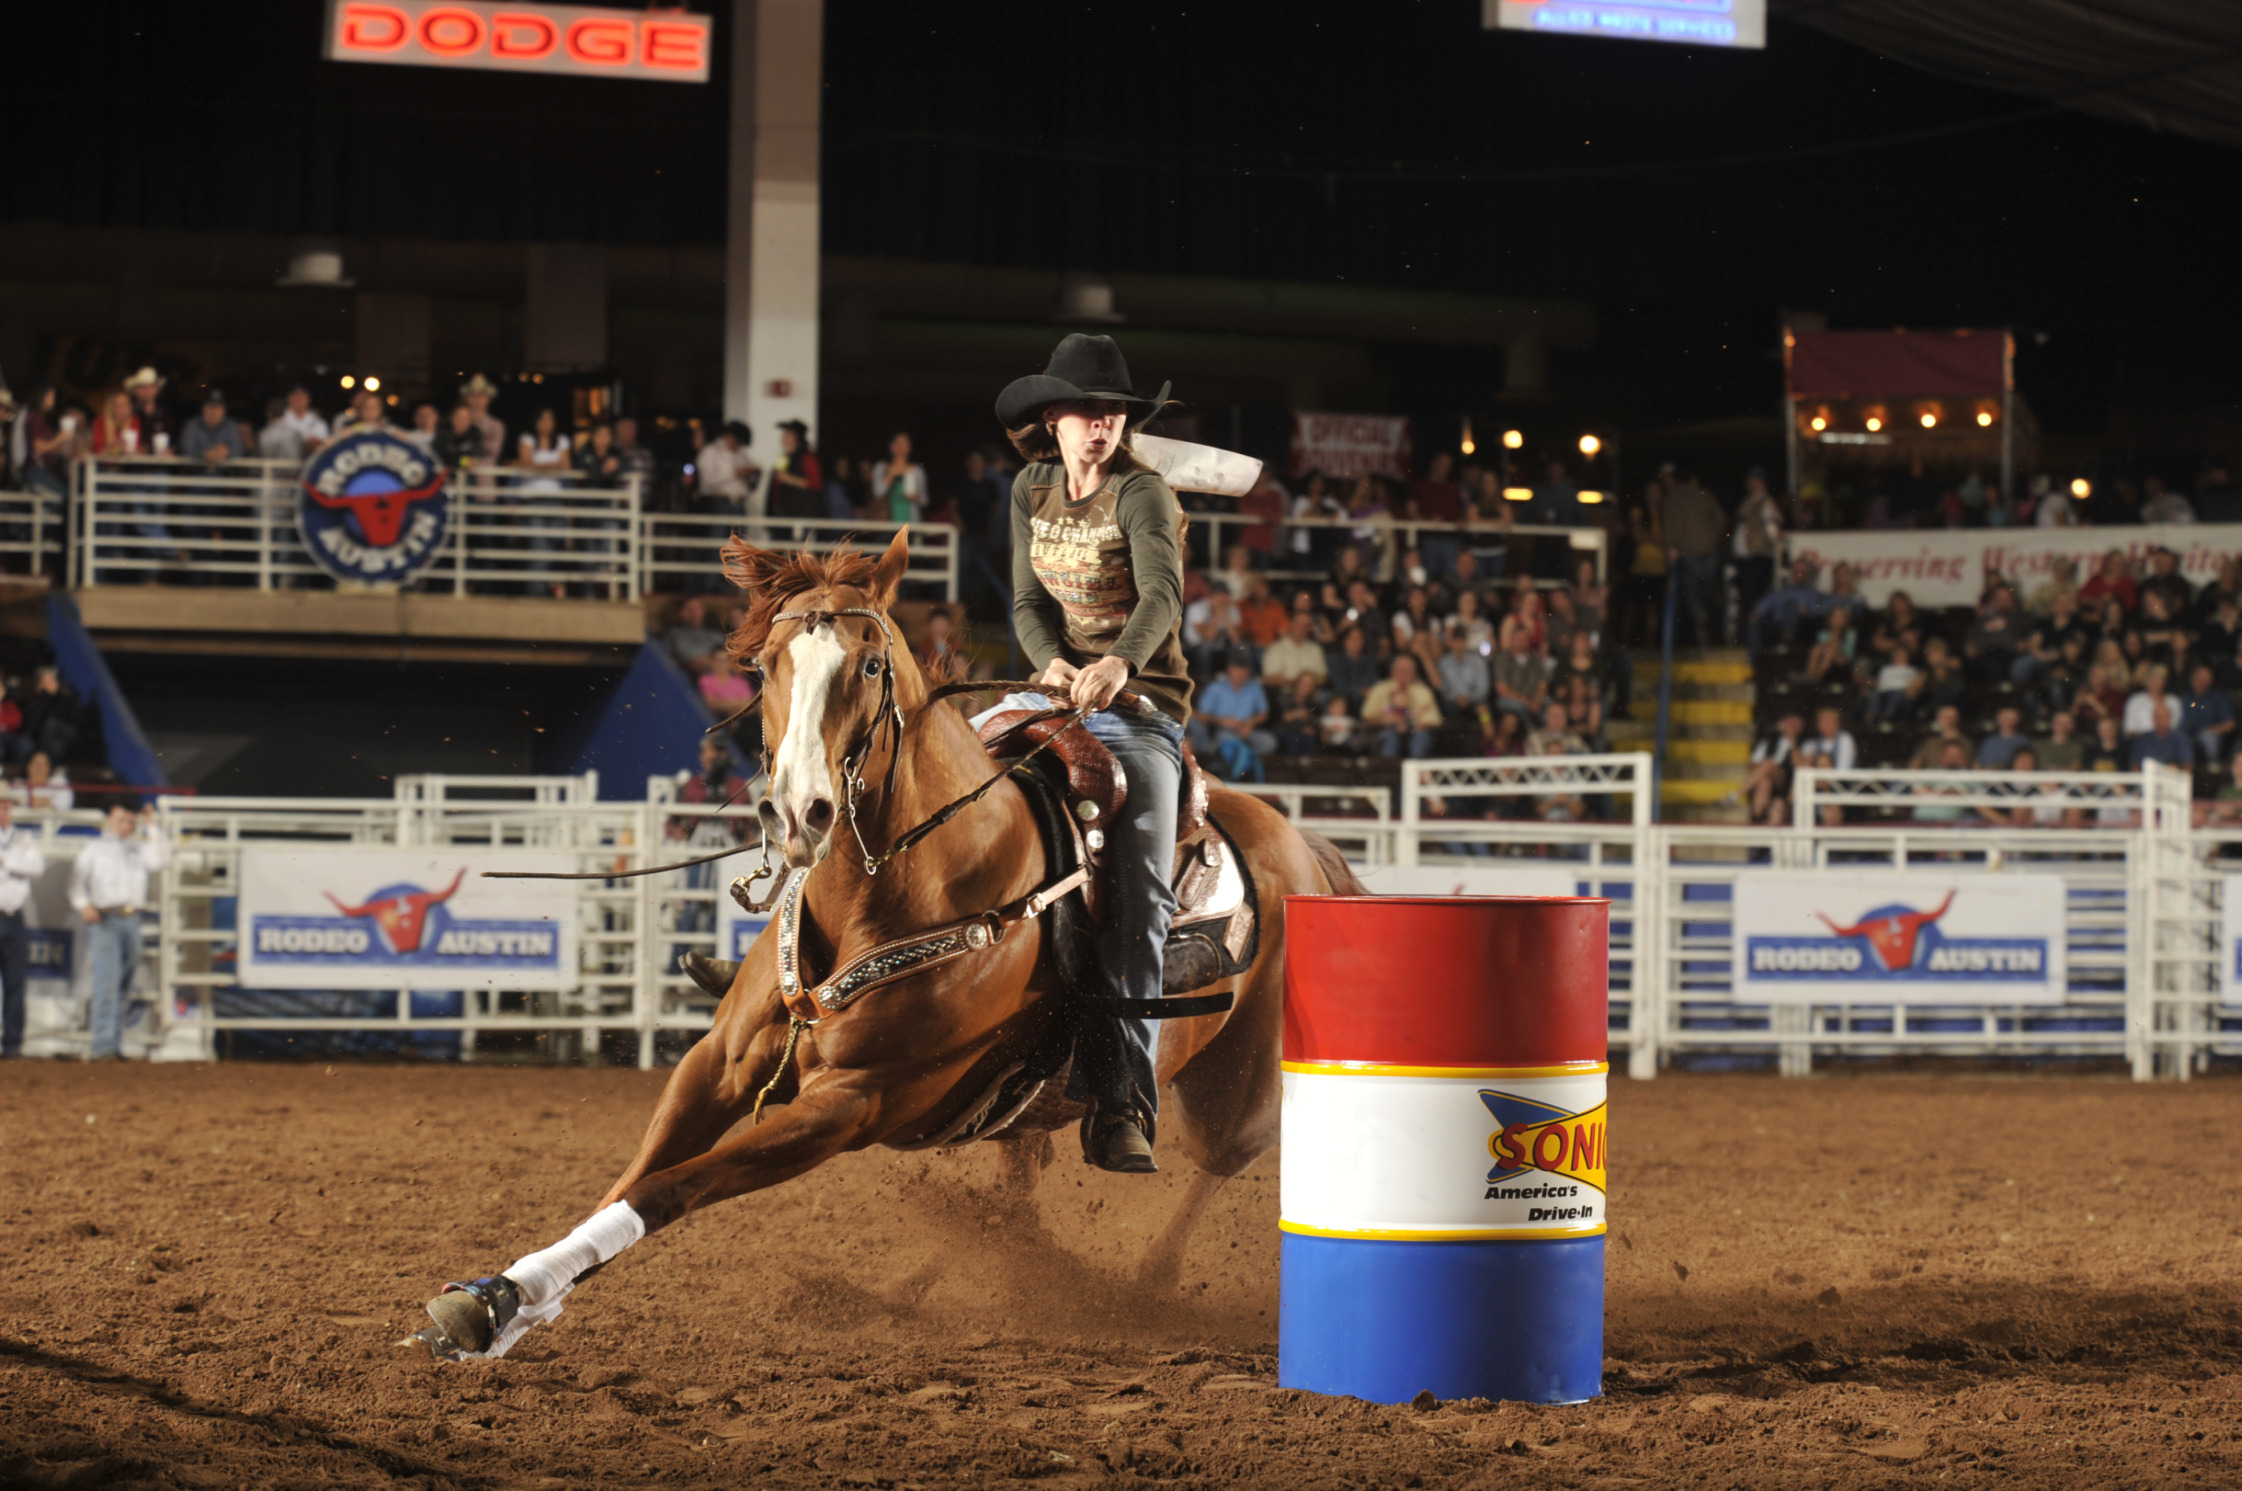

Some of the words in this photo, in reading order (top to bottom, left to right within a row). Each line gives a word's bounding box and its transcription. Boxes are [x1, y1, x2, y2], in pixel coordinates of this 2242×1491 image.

[342, 4, 705, 71] DODGE
[316, 443, 426, 499] RODEO
[318, 511, 437, 573] AUSTIN
[259, 928, 369, 953] RODEO
[436, 931, 552, 957] AUSTIN
[1753, 947, 1862, 972] RODEO
[1928, 948, 2042, 973] AUSTIN
[1484, 1182, 1578, 1200] America's
